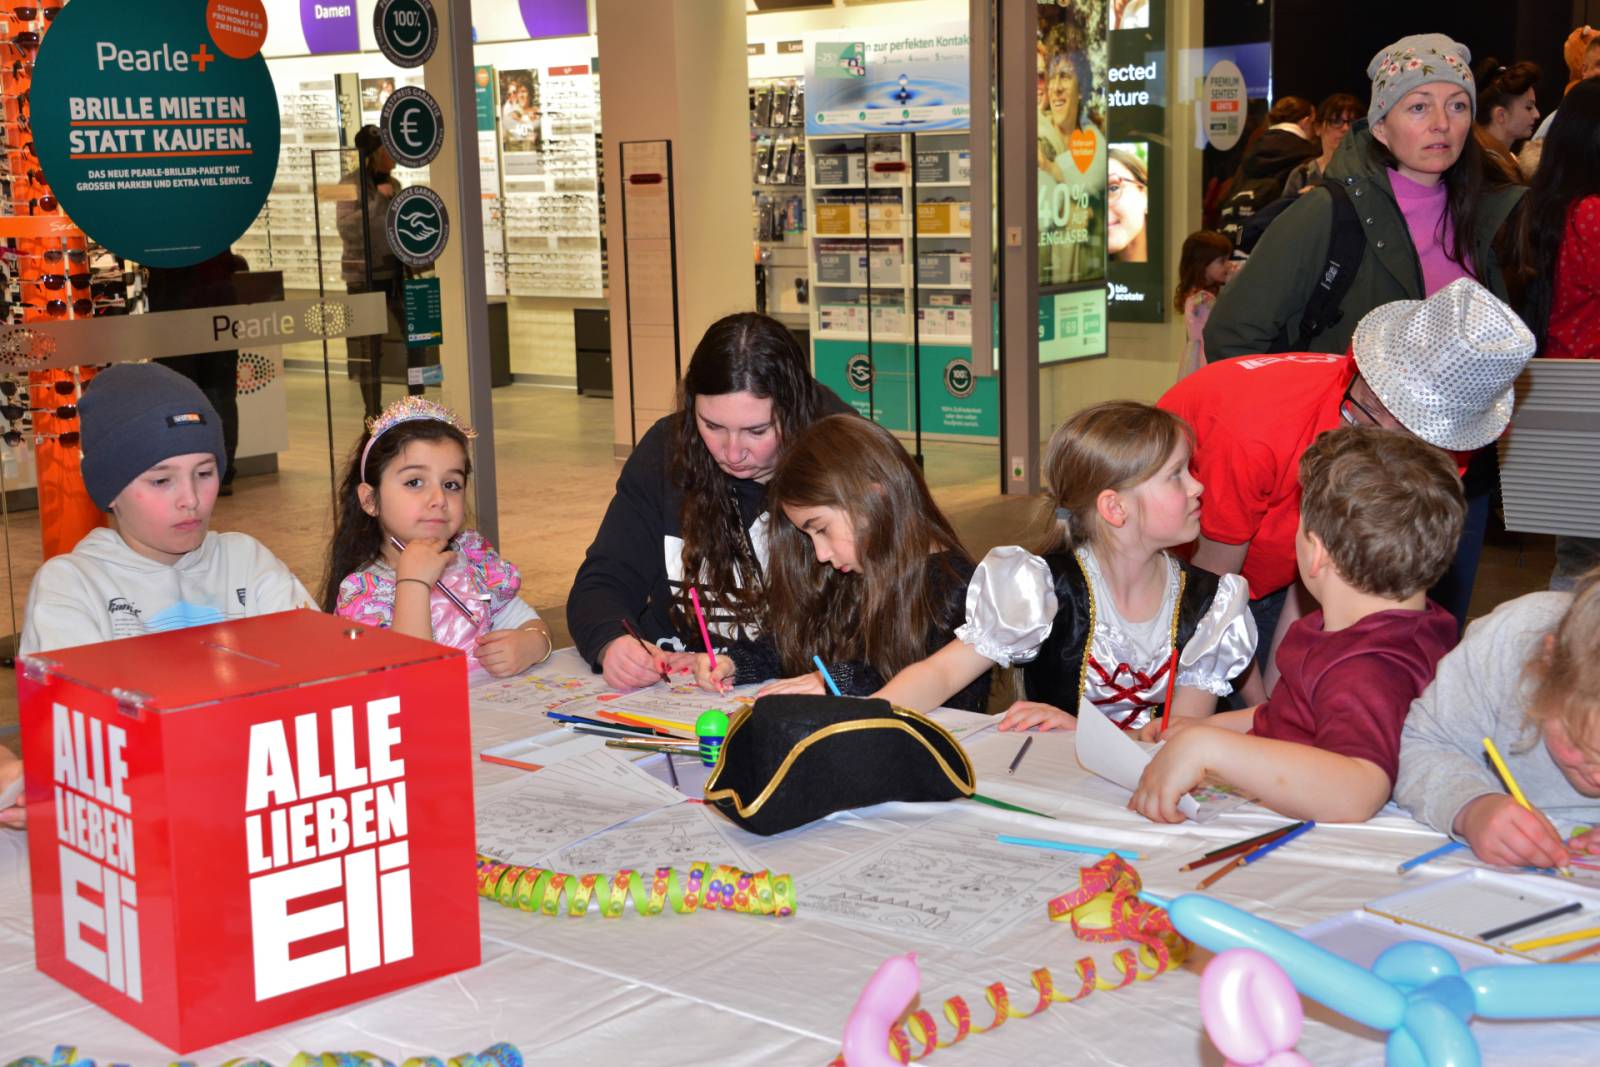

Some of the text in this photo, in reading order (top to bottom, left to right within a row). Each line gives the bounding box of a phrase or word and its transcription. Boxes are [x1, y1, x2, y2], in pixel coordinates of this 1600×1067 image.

[226, 15, 250, 27] MONAT
[314, 4, 351, 19] Damen
[393, 10, 421, 27] 100%
[216, 21, 259, 38] ZWEI BRILLEN
[873, 42, 888, 52] zur
[889, 38, 935, 54] perfekten
[1108, 62, 1156, 82] ected
[1210, 77, 1239, 87] PREMIUM
[69, 97, 246, 120] BRILLE MIETEN
[383, 88, 441, 118] BESTPREIS GARANTIE
[69, 127, 252, 153] STATT KAUFEN.
[76, 176, 253, 191] GROSSEN MARKEN UND EXTRA VIEL SERVICE.
[88, 165, 240, 179] DAS NEUE PEARLE-BRILLEN-PAKET MIT
[391, 186, 443, 211] SERVICE GARANTIE
[213, 311, 295, 341] Pearle
[52, 702, 132, 814] ALLE
[245, 696, 405, 812] ALLE
[54, 785, 136, 876] LIEBEN
[245, 781, 408, 874] LIEBEN
[58, 844, 143, 1004] Eli
[249, 840, 414, 1002] Eli
